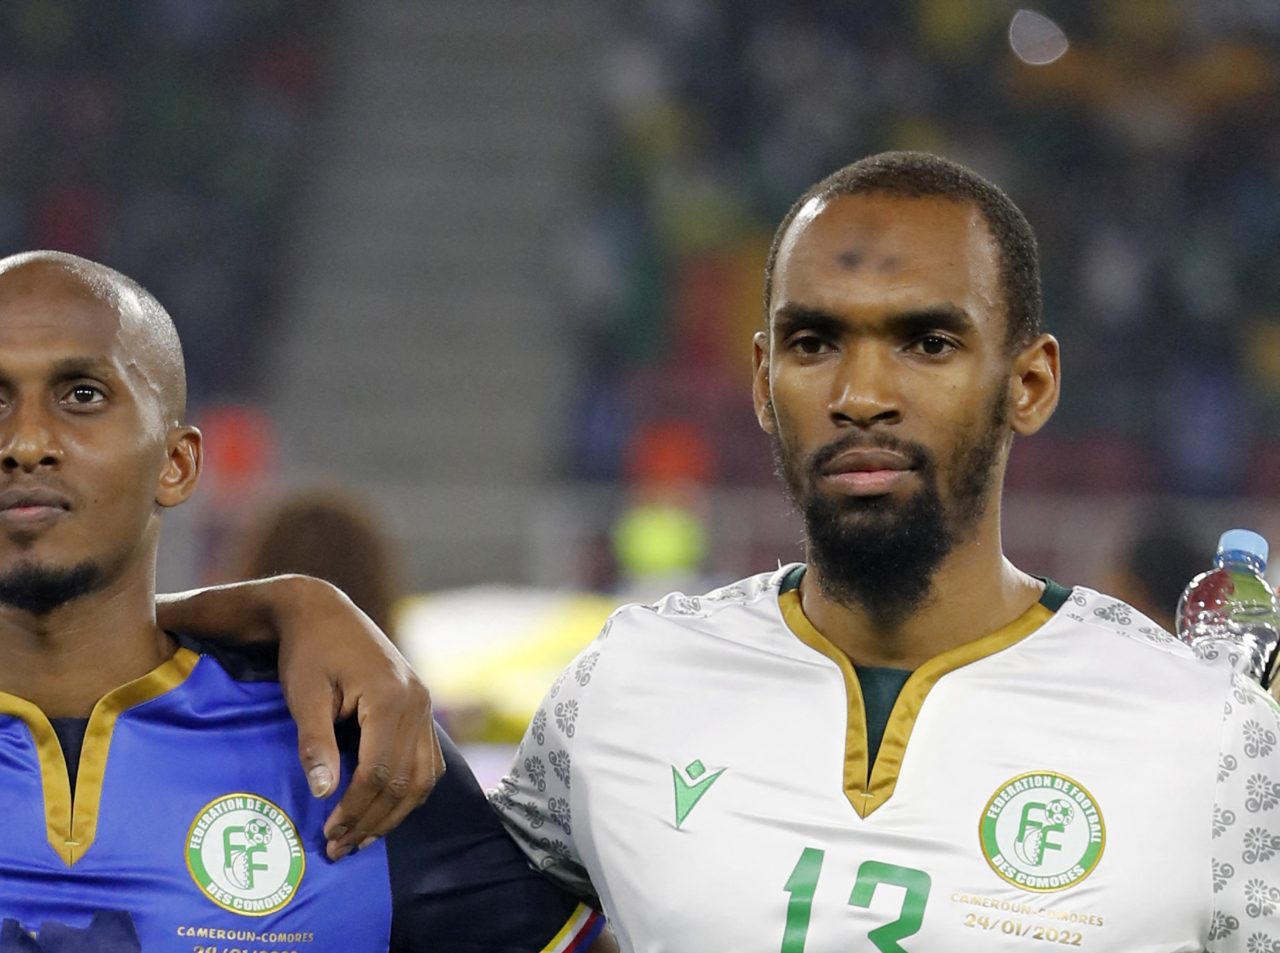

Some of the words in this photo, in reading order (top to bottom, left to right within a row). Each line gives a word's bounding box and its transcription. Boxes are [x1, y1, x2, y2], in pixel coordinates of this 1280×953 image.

[987, 775, 1051, 819] FEDERATION
[1053, 777, 1071, 793] DE
[1070, 784, 1102, 843] FOOTBALL
[190, 797, 244, 849] FEDERATION
[246, 798, 262, 812] DE
[262, 803, 301, 858] FOOTBALL
[991, 854, 1017, 878] DES
[1016, 864, 1086, 888] COMORES
[206, 882, 233, 905] DES
[233, 882, 294, 911] COMORES
[177, 926, 314, 943] CAMEROUN-COMORES
[964, 913, 1083, 946] 24/01/2022
